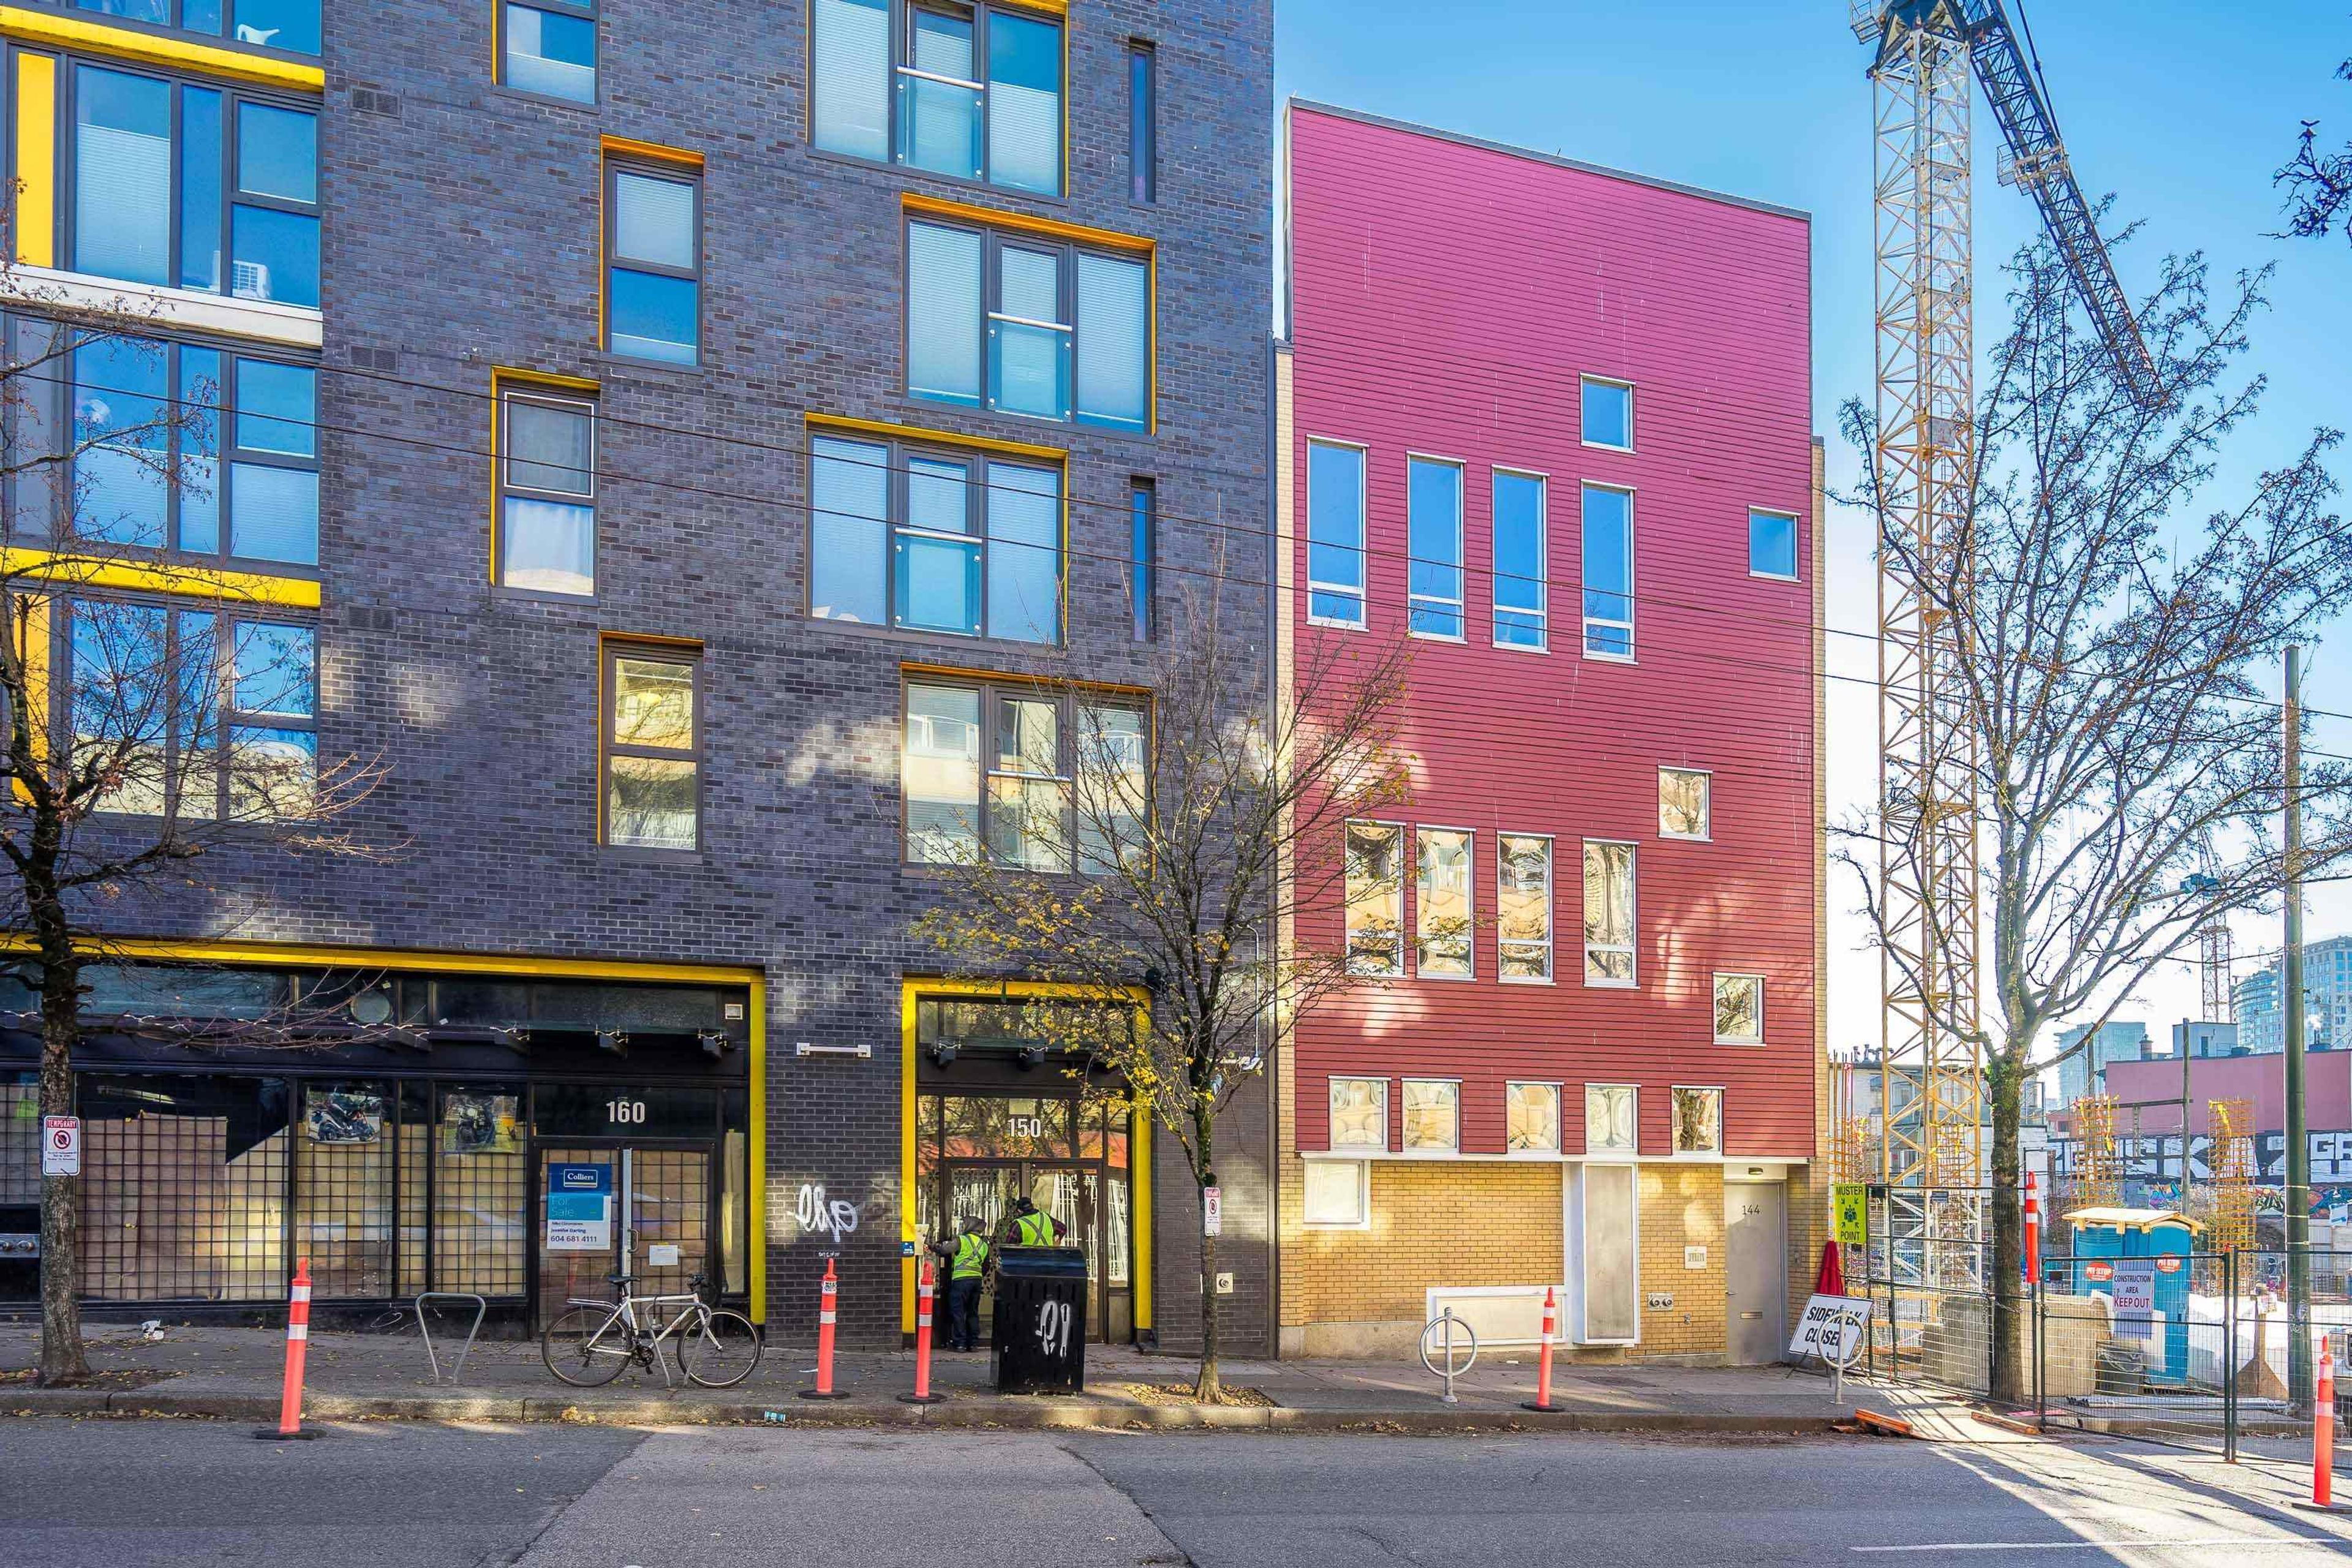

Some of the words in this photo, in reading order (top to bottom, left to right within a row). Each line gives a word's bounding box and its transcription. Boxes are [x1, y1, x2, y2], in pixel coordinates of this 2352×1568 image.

[606, 1101, 645, 1123] 160
[1008, 1118, 1041, 1137] 150
[567, 1172, 594, 1181] Colliers
[1836, 1186, 1863, 1196] MUSTER
[552, 1196, 567, 1205] For
[1742, 1204, 1760, 1215] 144
[1841, 1231, 1860, 1240] POINT
[2114, 1297, 2133, 1308] KEEP
[2134, 1297, 2149, 1308] OUT
[1806, 1306, 1863, 1327] SIDEWLK
